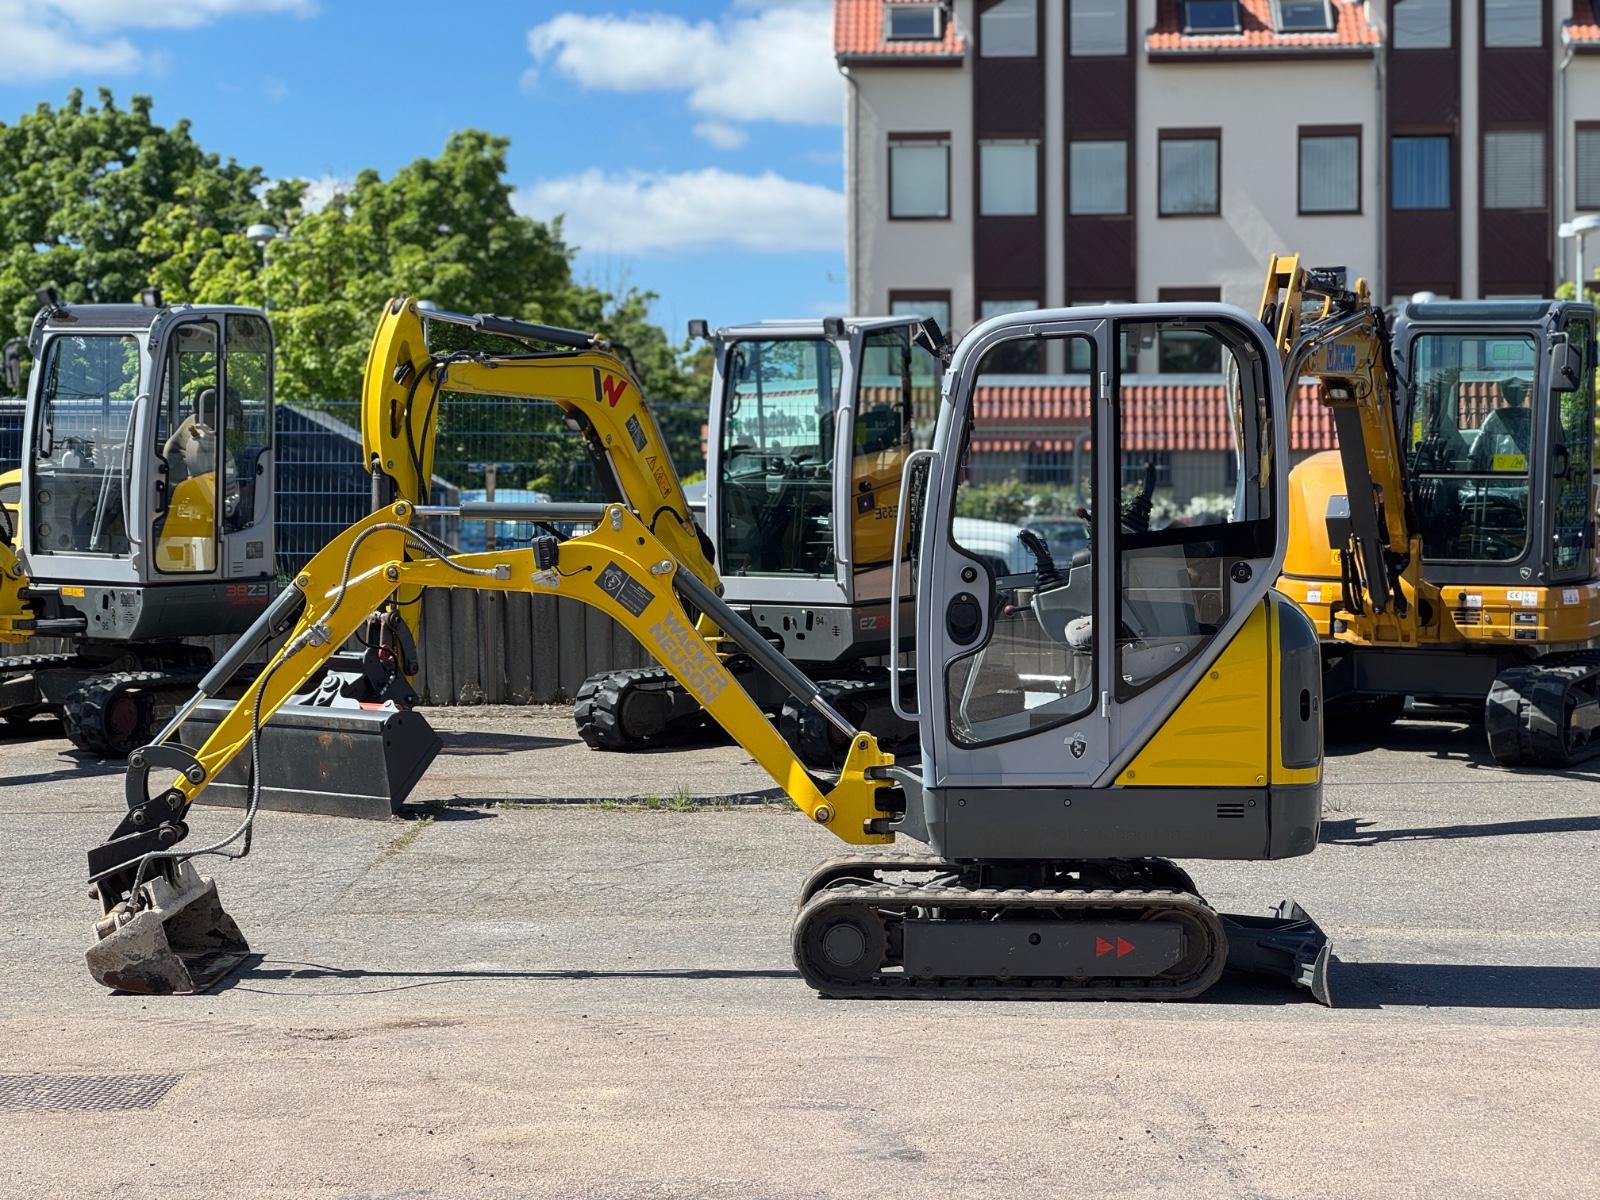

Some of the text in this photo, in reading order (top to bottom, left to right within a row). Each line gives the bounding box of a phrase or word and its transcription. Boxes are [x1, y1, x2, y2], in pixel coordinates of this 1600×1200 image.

[648, 623, 718, 704] NEUSON
[663, 609, 729, 694] WACKER
[860, 616, 890, 630] EZ
